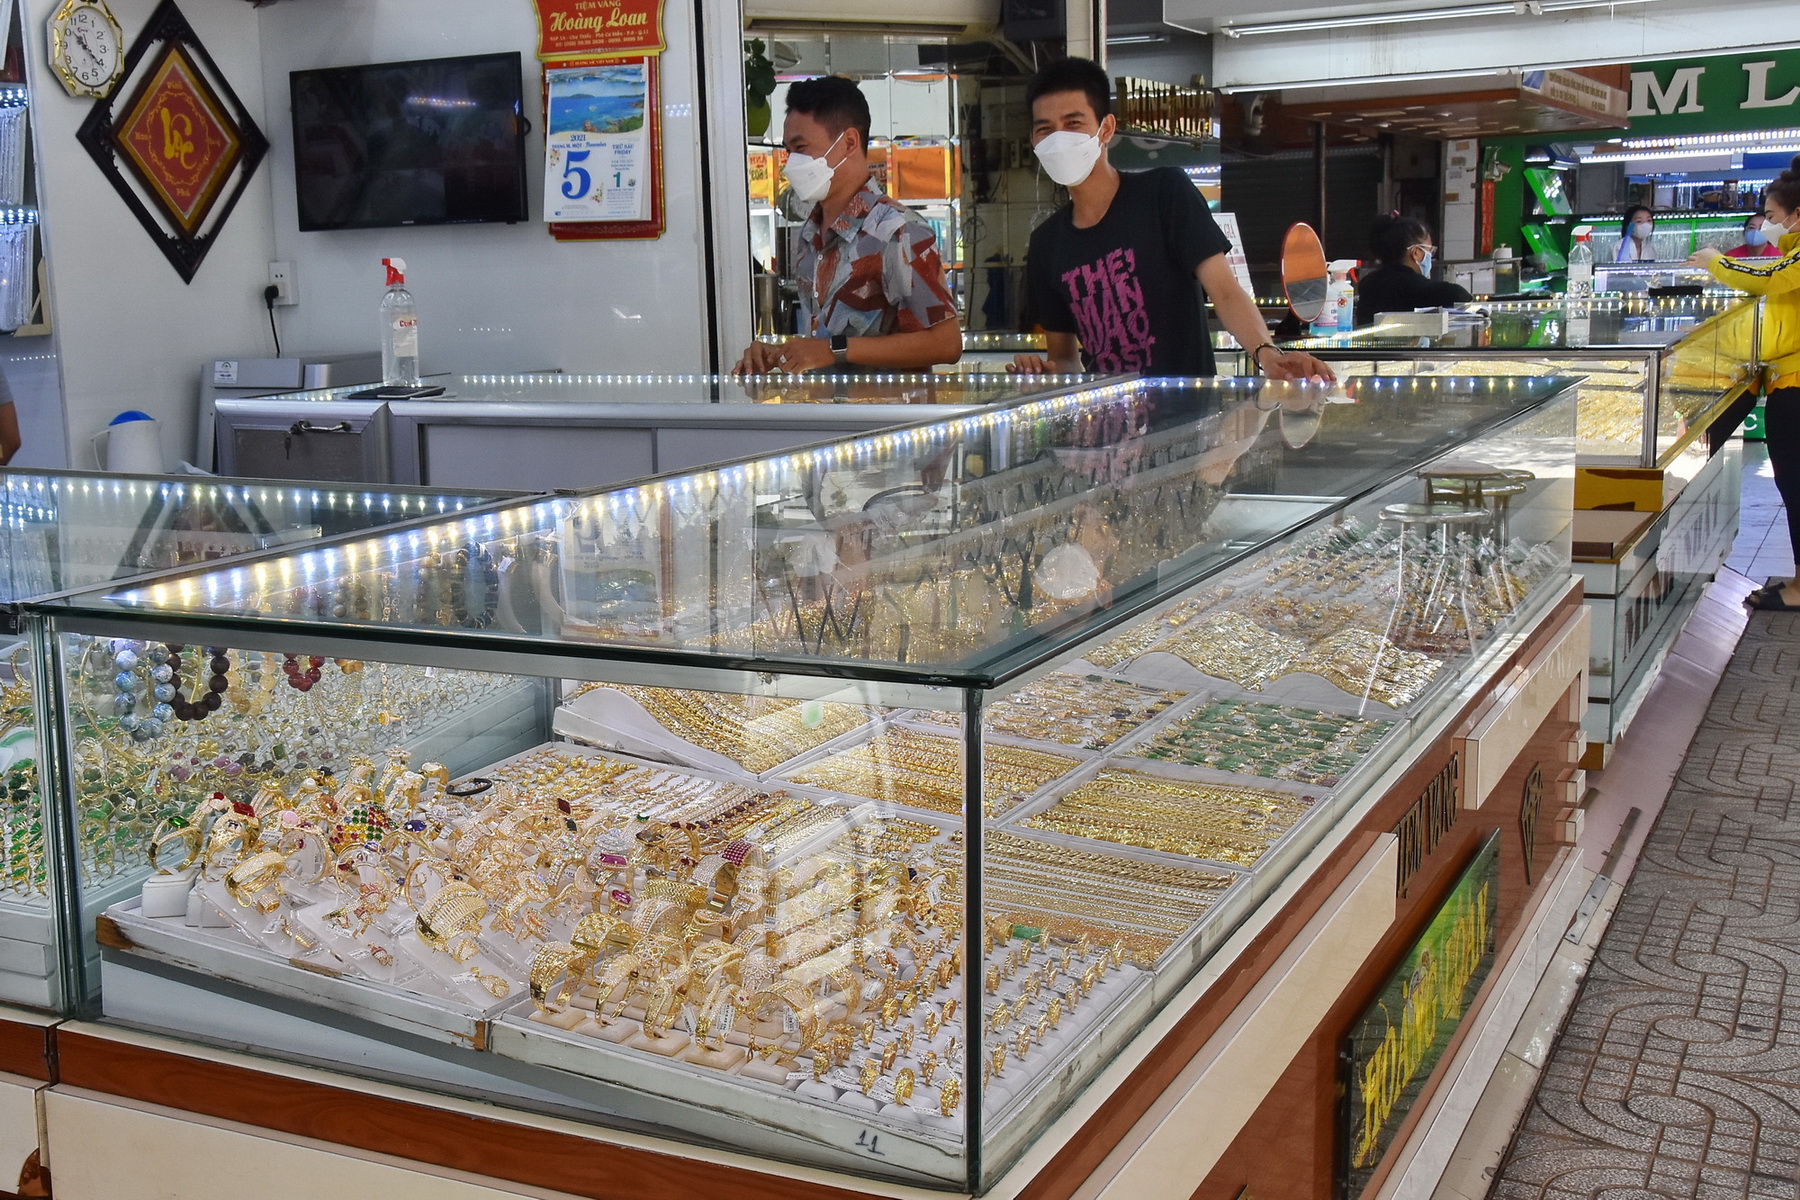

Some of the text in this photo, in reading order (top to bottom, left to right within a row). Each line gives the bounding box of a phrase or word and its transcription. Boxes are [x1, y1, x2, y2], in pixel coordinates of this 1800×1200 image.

[70, 18, 77, 26] 11
[79, 14, 88, 23] 12
[549, 7, 648, 33] Hoàng Loan
[91, 20, 95, 28] 1
[96, 31, 104, 40] 2
[100, 45, 107, 54] 3
[72, 66, 79, 76] 7
[91, 68, 99, 77] 5
[82, 72, 89, 80] 6
[561, 150, 591, 199] 5
[612, 171, 621, 188] 1
